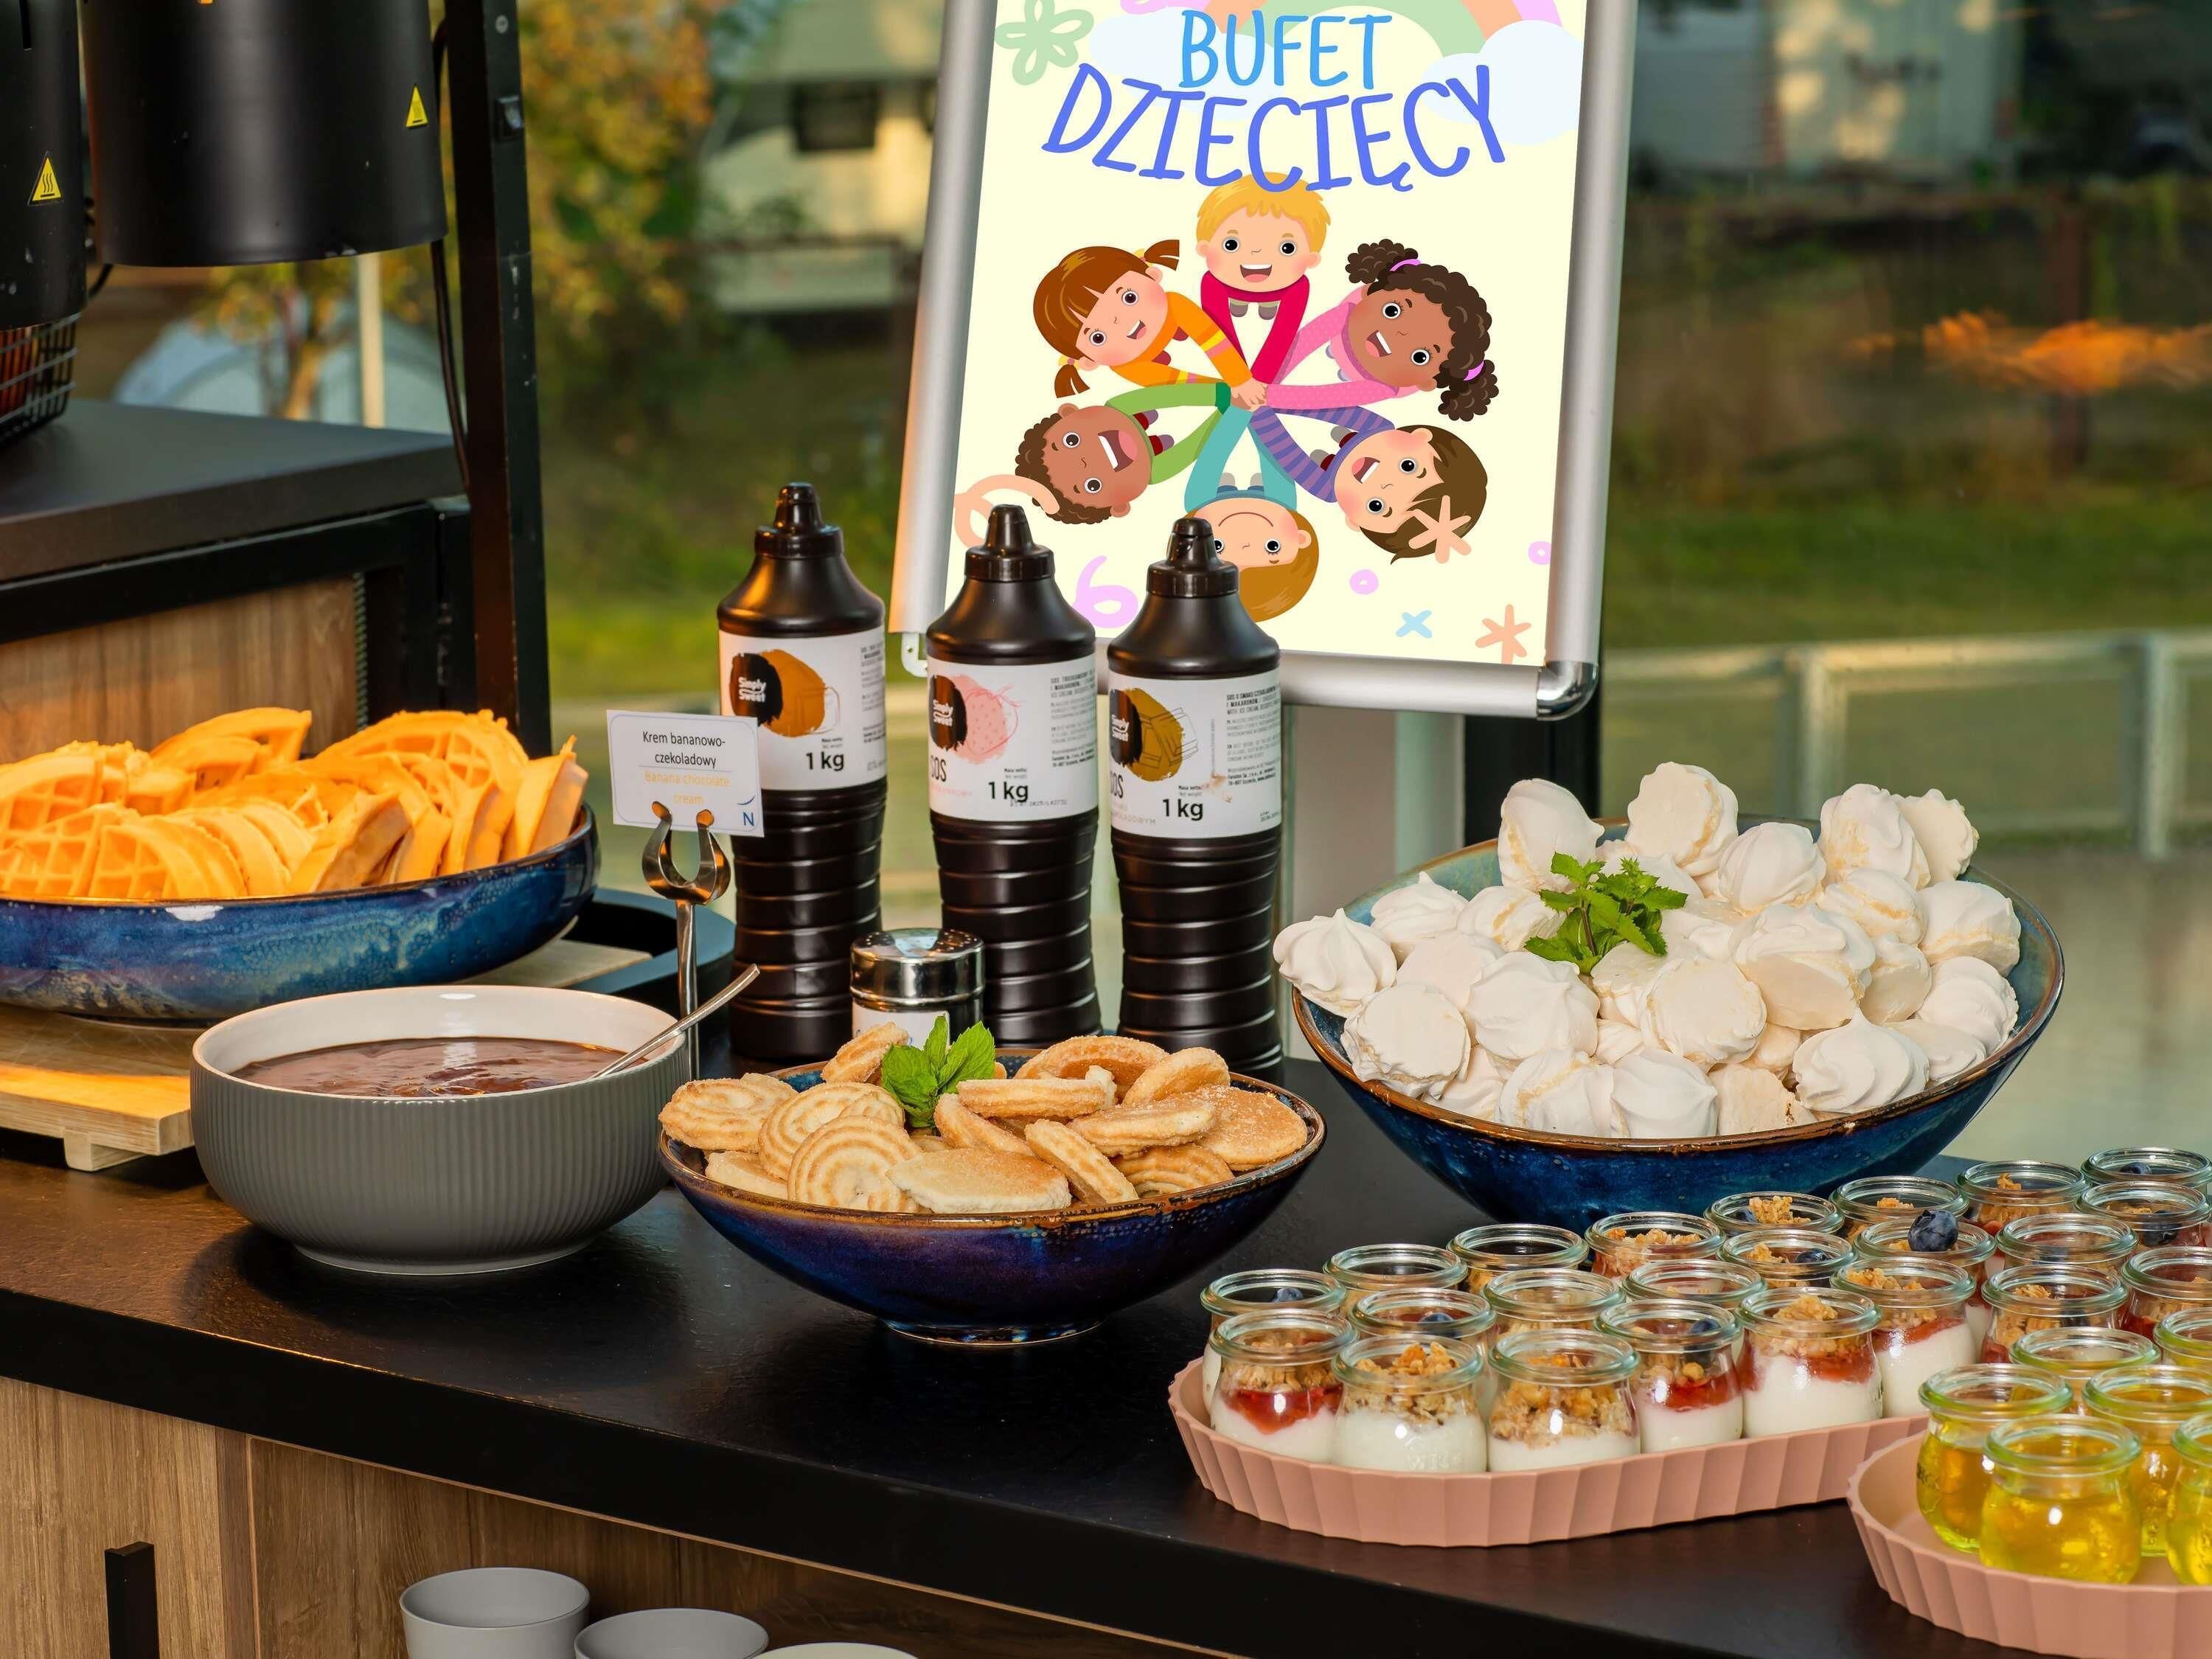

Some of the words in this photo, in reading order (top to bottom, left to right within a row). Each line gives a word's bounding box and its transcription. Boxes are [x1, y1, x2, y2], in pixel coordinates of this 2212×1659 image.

[1178, 10, 1393, 89] BUFET
[1040, 63, 1506, 192] DZIECIĘCY
[642, 731, 668, 743] Krem
[670, 732, 726, 747] bananowo-
[655, 751, 716, 769] czekoladowy
[806, 752, 813, 770] 1
[821, 751, 844, 771] kg
[672, 793, 704, 804] cream
[988, 782, 995, 799] 1
[1004, 781, 1029, 803] kg
[742, 812, 754, 827] N
[1162, 799, 1169, 817] 1
[1177, 798, 1203, 821] kg
